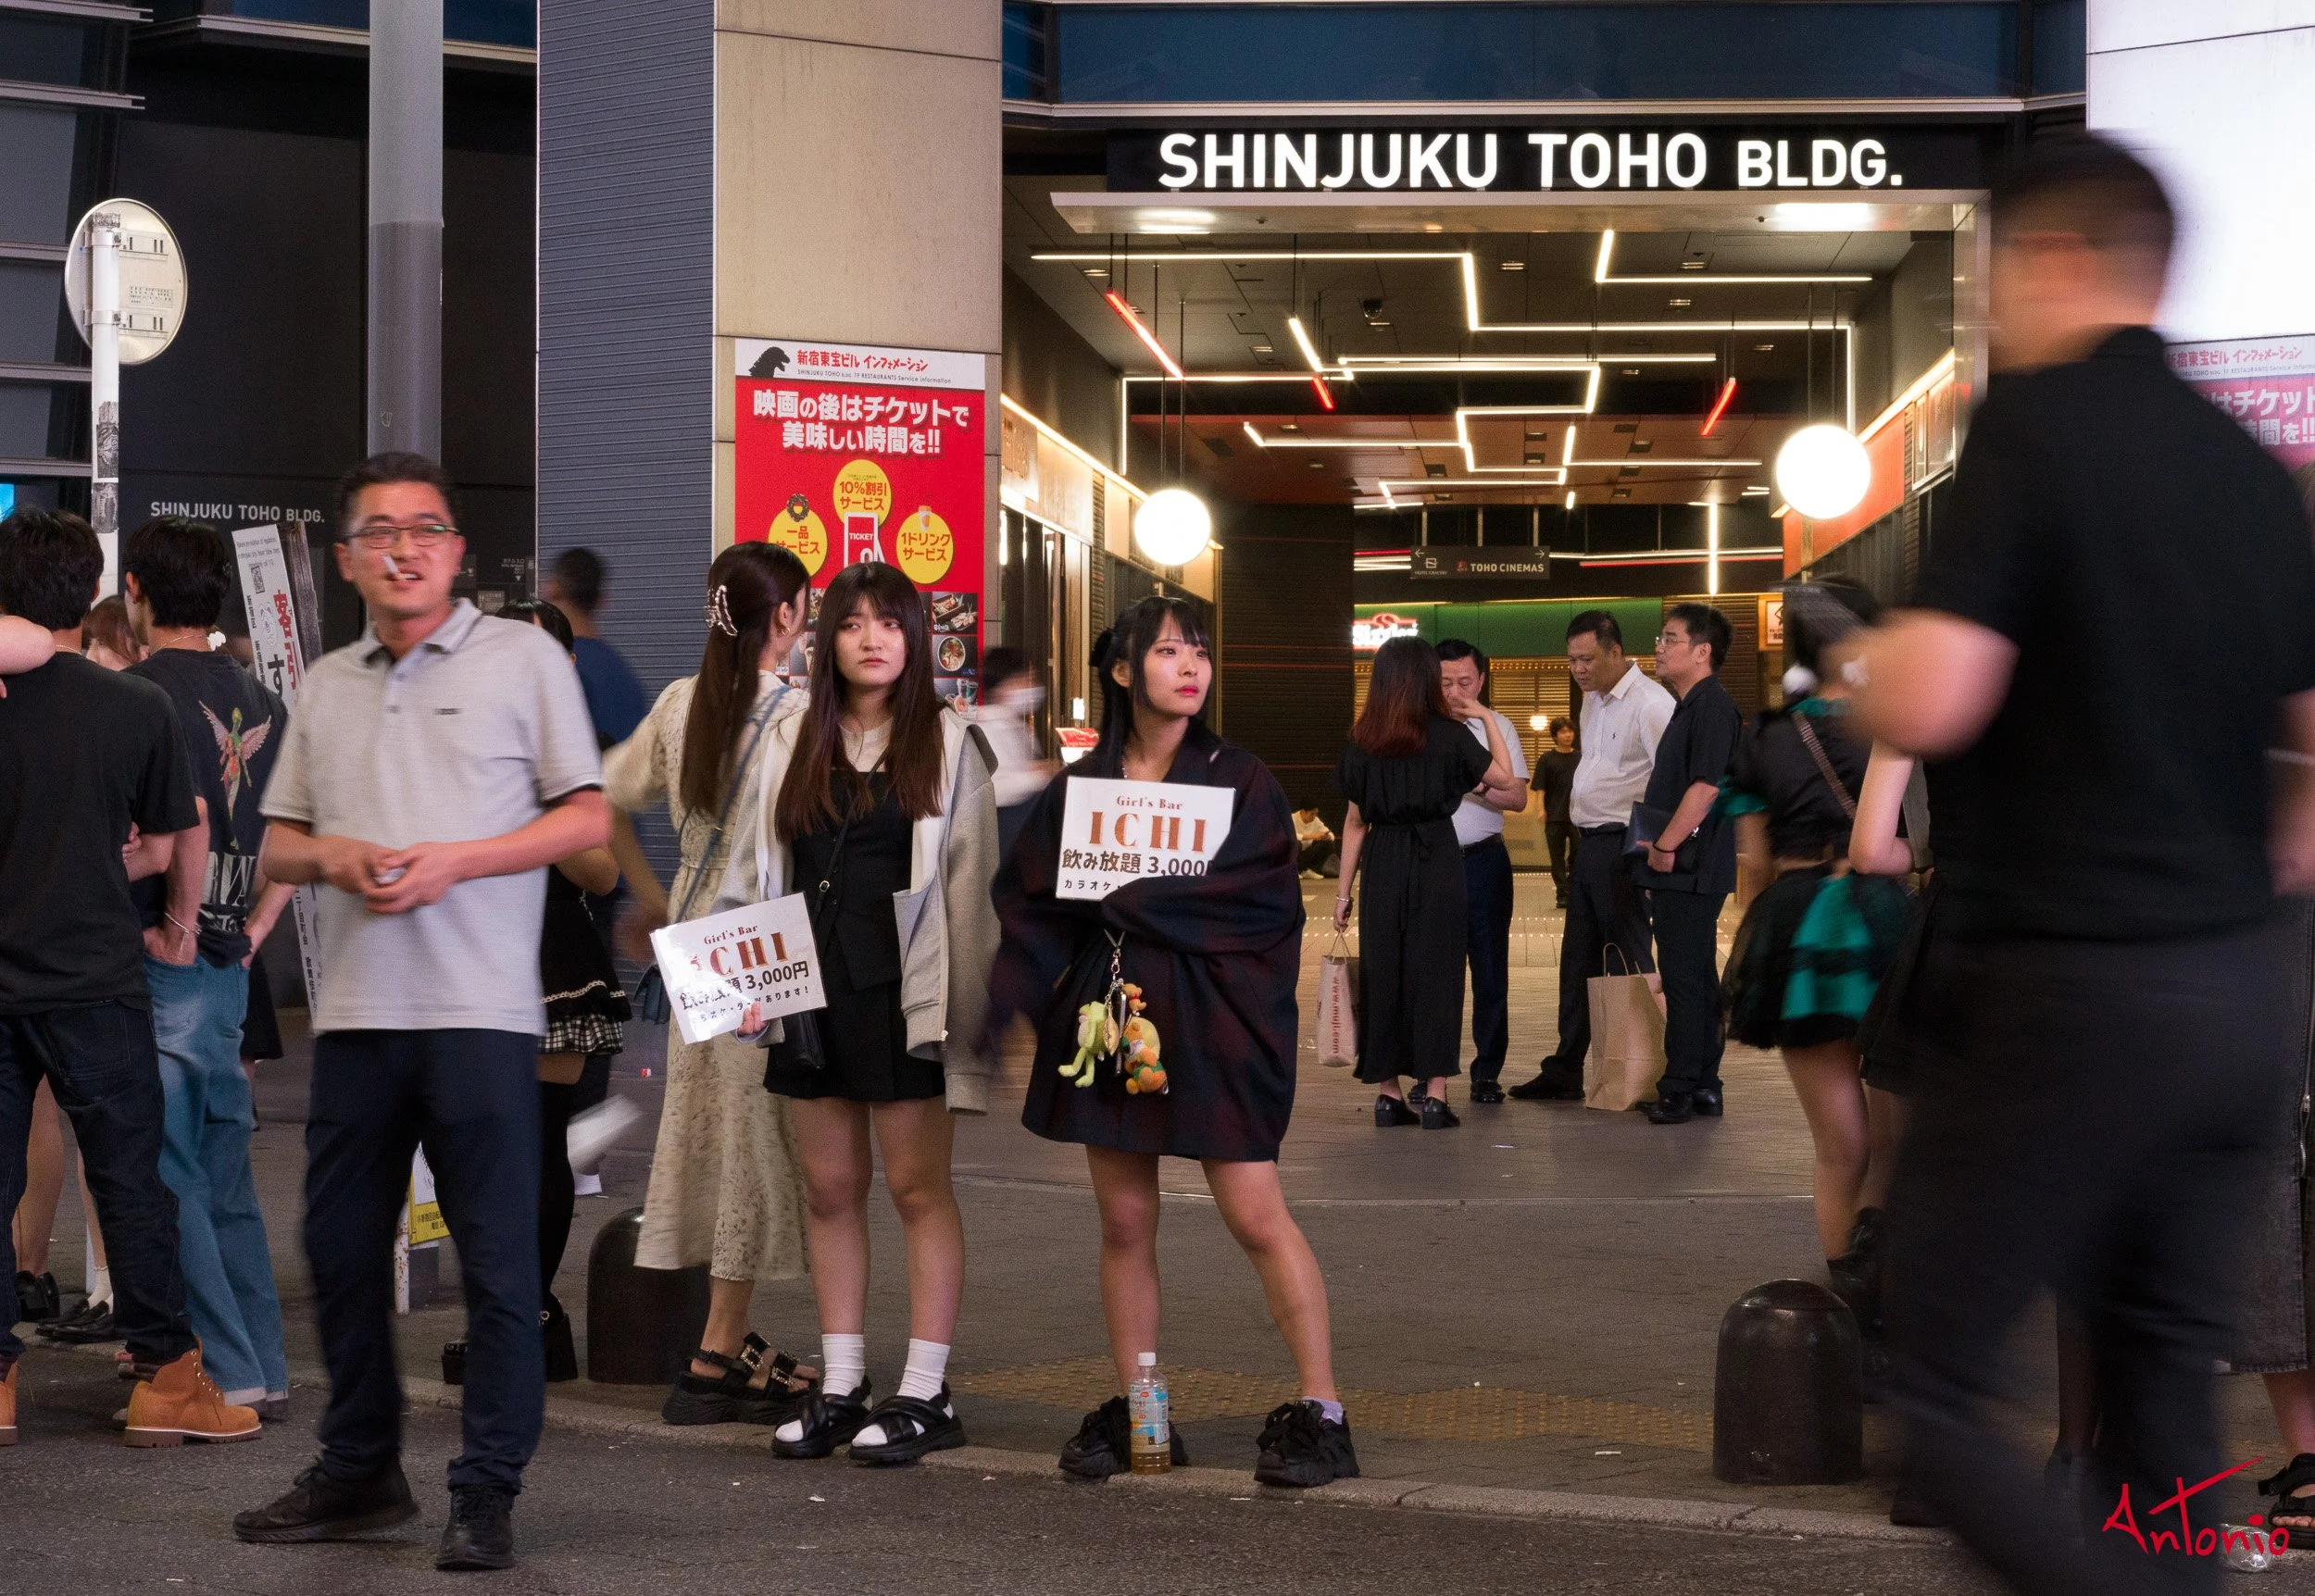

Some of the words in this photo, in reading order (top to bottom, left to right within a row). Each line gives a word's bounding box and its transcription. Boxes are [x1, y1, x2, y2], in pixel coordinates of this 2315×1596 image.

[1158, 133, 1497, 188] SHINJUKU
[1528, 132, 1707, 189] TOHO
[1737, 139, 1903, 188] BLDG.
[797, 350, 860, 368] 新宿東宝ビル
[863, 355, 929, 372] インフォメーション
[861, 372, 897, 381] RESTAURANTS
[753, 389, 970, 428] 映画の後はチケットで
[782, 420, 940, 455] 美味しい時間を!!
[839, 480, 887, 496] 10%割引
[150, 501, 232, 519] SHINJUKU
[238, 505, 281, 521] TOHO
[286, 508, 325, 523] BLDG.
[839, 497, 884, 511] サービス
[786, 525, 809, 540] 一品
[849, 532, 874, 541] TICKET
[901, 532, 951, 547] 1ドリンク
[902, 547, 946, 562] サービス
[1470, 563, 1497, 572] TOHO
[1499, 563, 1545, 572] CINEMAS
[1116, 794, 1154, 808] Girl's
[1159, 798, 1183, 810] Bar
[1088, 810, 1207, 854] ICHI
[1061, 848, 1142, 875] 飲み放題
[704, 929, 735, 945] Girl's
[738, 925, 758, 936] Bar
[745, 960, 809, 991] 3,000円
